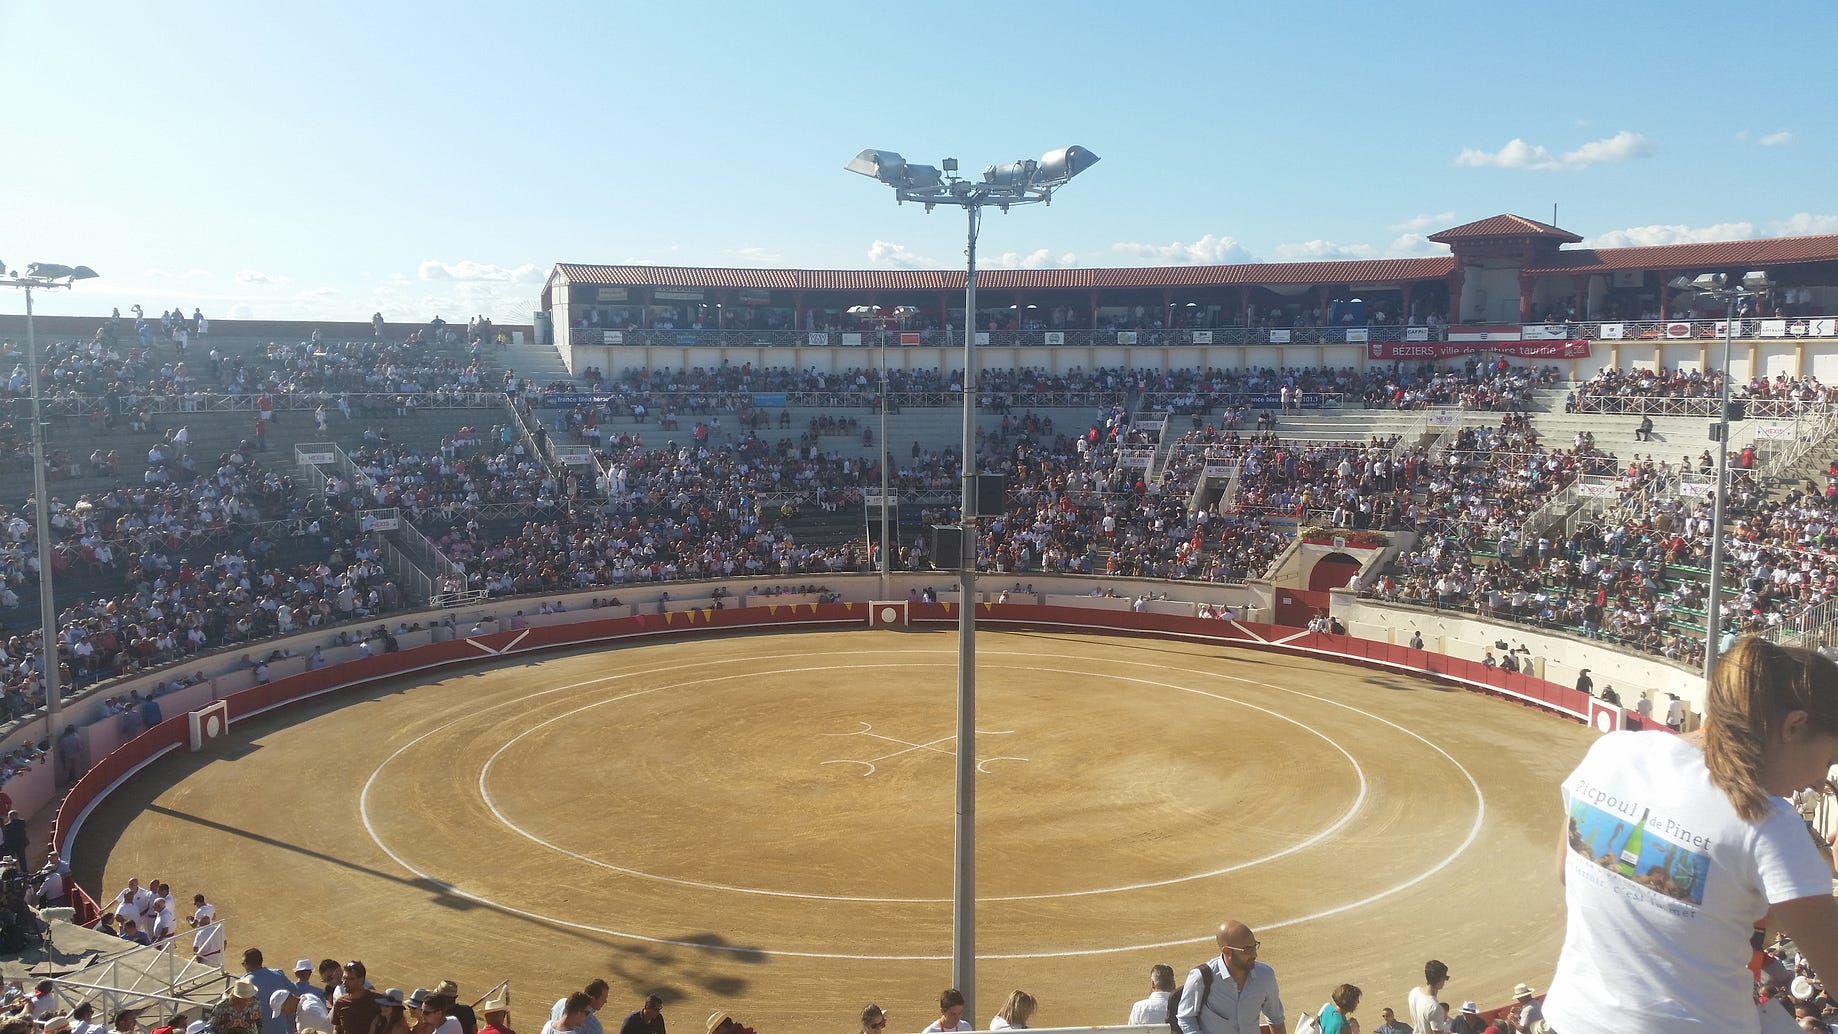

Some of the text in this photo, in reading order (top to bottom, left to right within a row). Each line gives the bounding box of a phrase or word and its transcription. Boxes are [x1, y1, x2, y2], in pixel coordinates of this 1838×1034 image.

[1440, 346, 1460, 355] ville
[1463, 346, 1475, 354] de
[1479, 346, 1516, 354] culture
[1519, 346, 1557, 355] taurine
[1575, 780, 1712, 851] Picpoul de Pinet
[1669, 906, 1696, 918] mer
